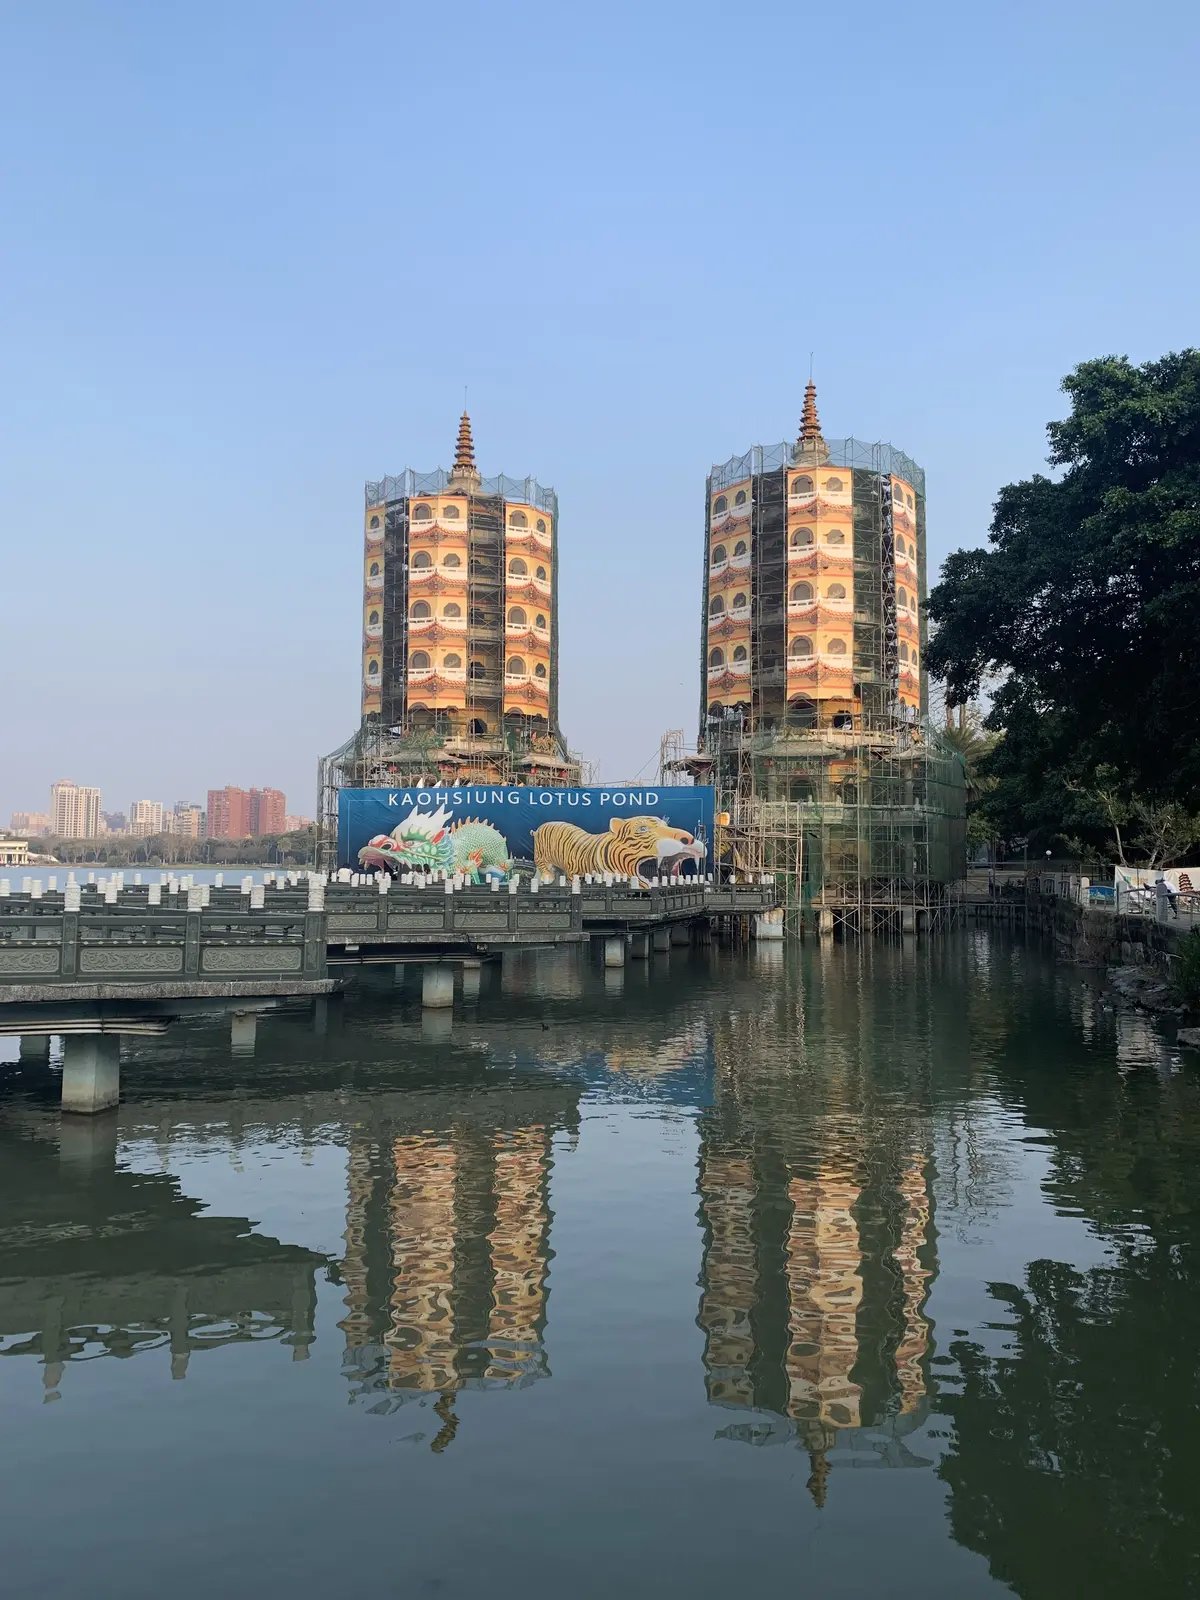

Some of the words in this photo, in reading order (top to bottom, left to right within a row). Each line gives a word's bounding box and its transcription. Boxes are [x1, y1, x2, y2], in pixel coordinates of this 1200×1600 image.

[388, 790, 520, 807] KAOHSIUNG
[529, 792, 592, 806] LOTUS
[600, 792, 659, 806] POND
